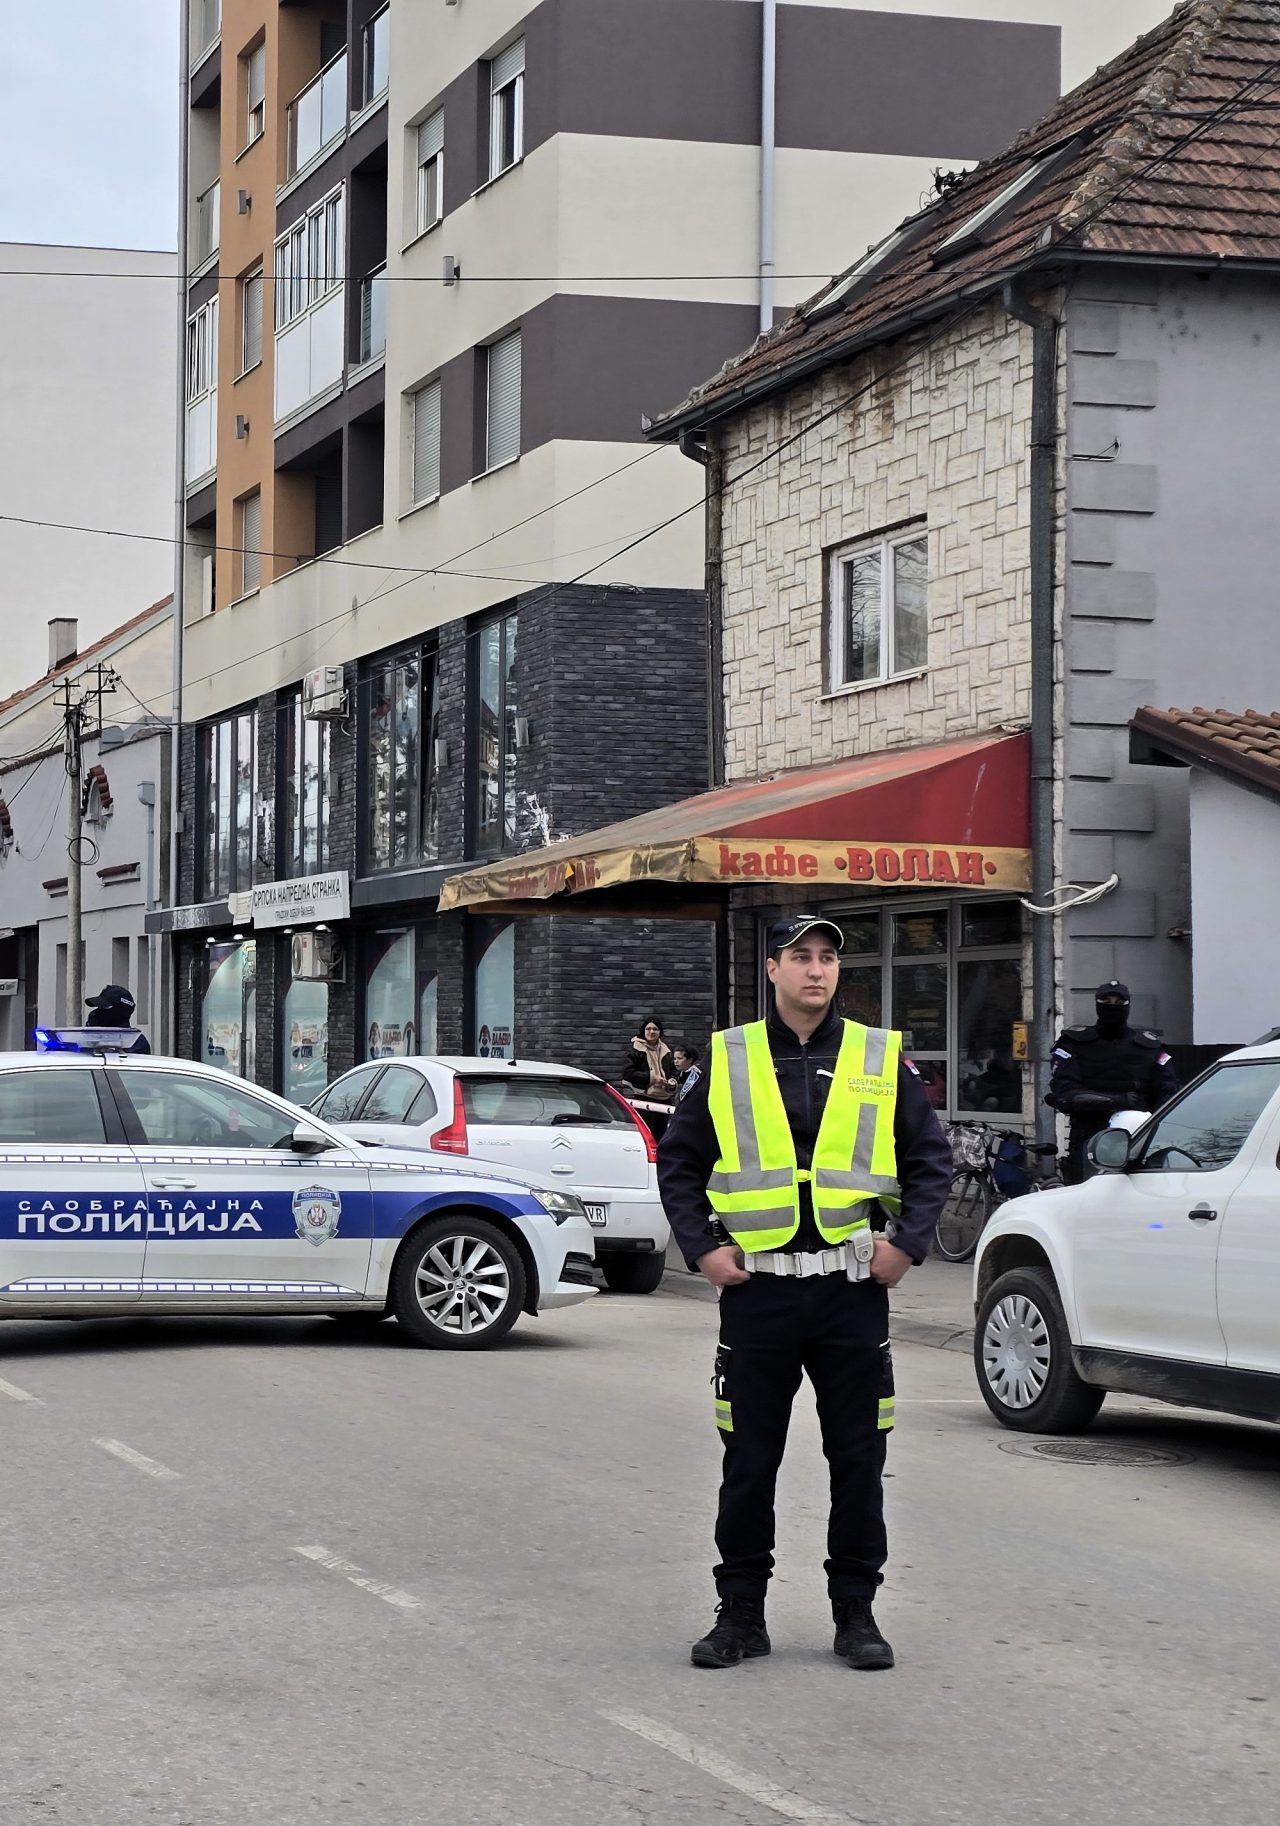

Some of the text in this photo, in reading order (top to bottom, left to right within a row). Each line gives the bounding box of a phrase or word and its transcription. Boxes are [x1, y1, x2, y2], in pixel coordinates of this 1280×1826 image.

[254, 878, 341, 907] СРПСКА НАПРЕДНА СТРАНКА
[848, 1086, 895, 1096] ПОЛИЦИЈА
[18, 1200, 264, 1211] САОБРАЋАЈНА
[18, 1212, 263, 1235] ПОЛИЦИЈА
